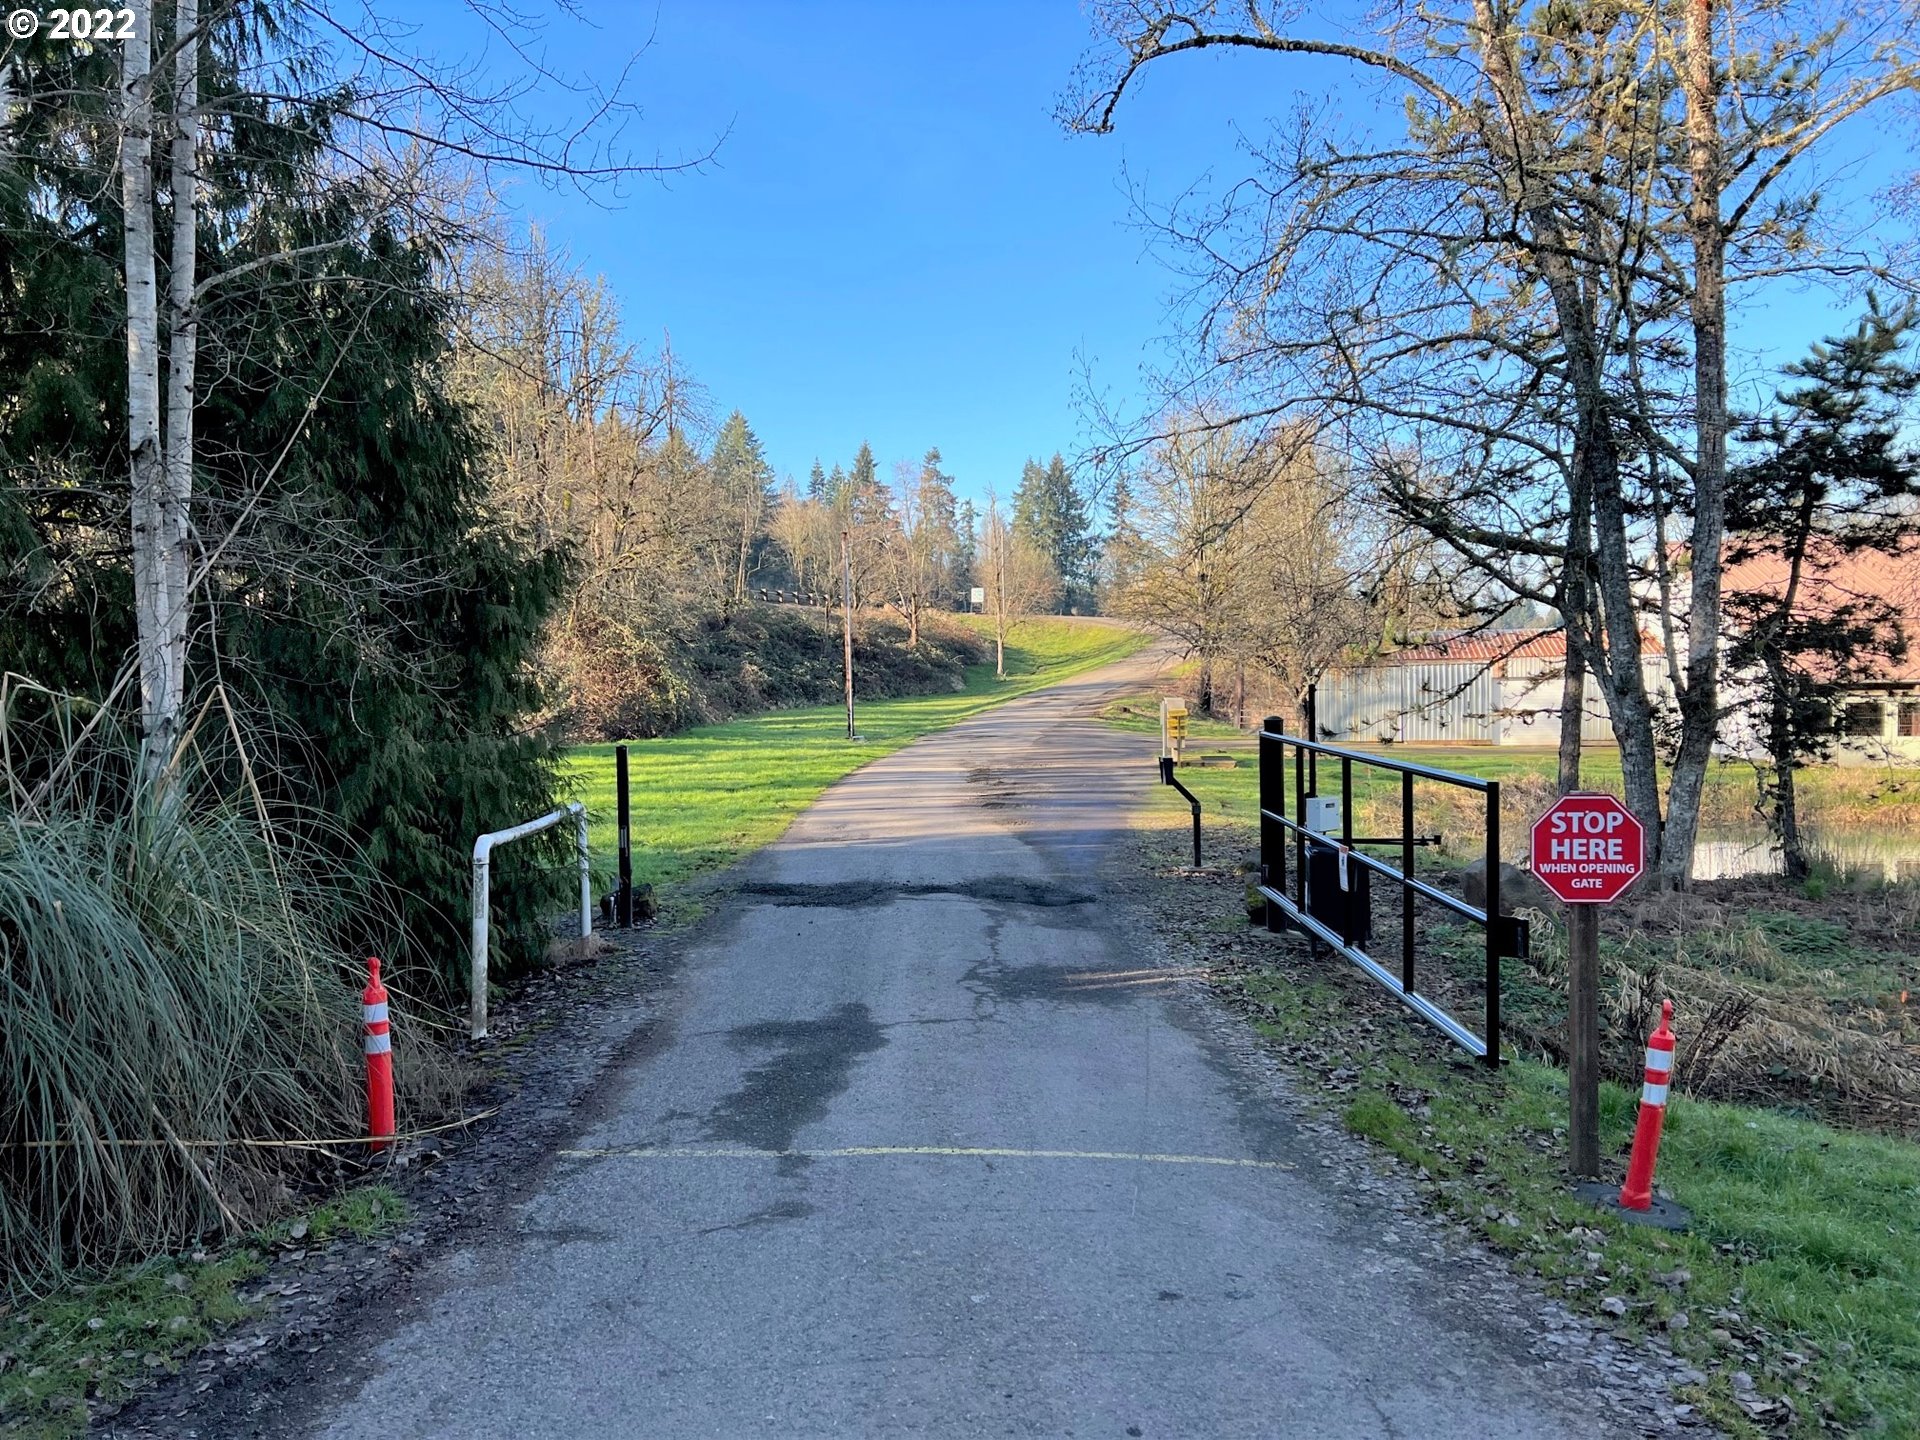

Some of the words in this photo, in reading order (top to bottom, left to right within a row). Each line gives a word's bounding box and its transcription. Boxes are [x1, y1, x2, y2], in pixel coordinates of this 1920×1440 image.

[1551, 811, 1624, 833] STOP
[1551, 839, 1623, 860] HERE
[1540, 864, 1577, 873] WHEN
[1579, 864, 1635, 874] OPENING
[1571, 879, 1603, 888] GATE
